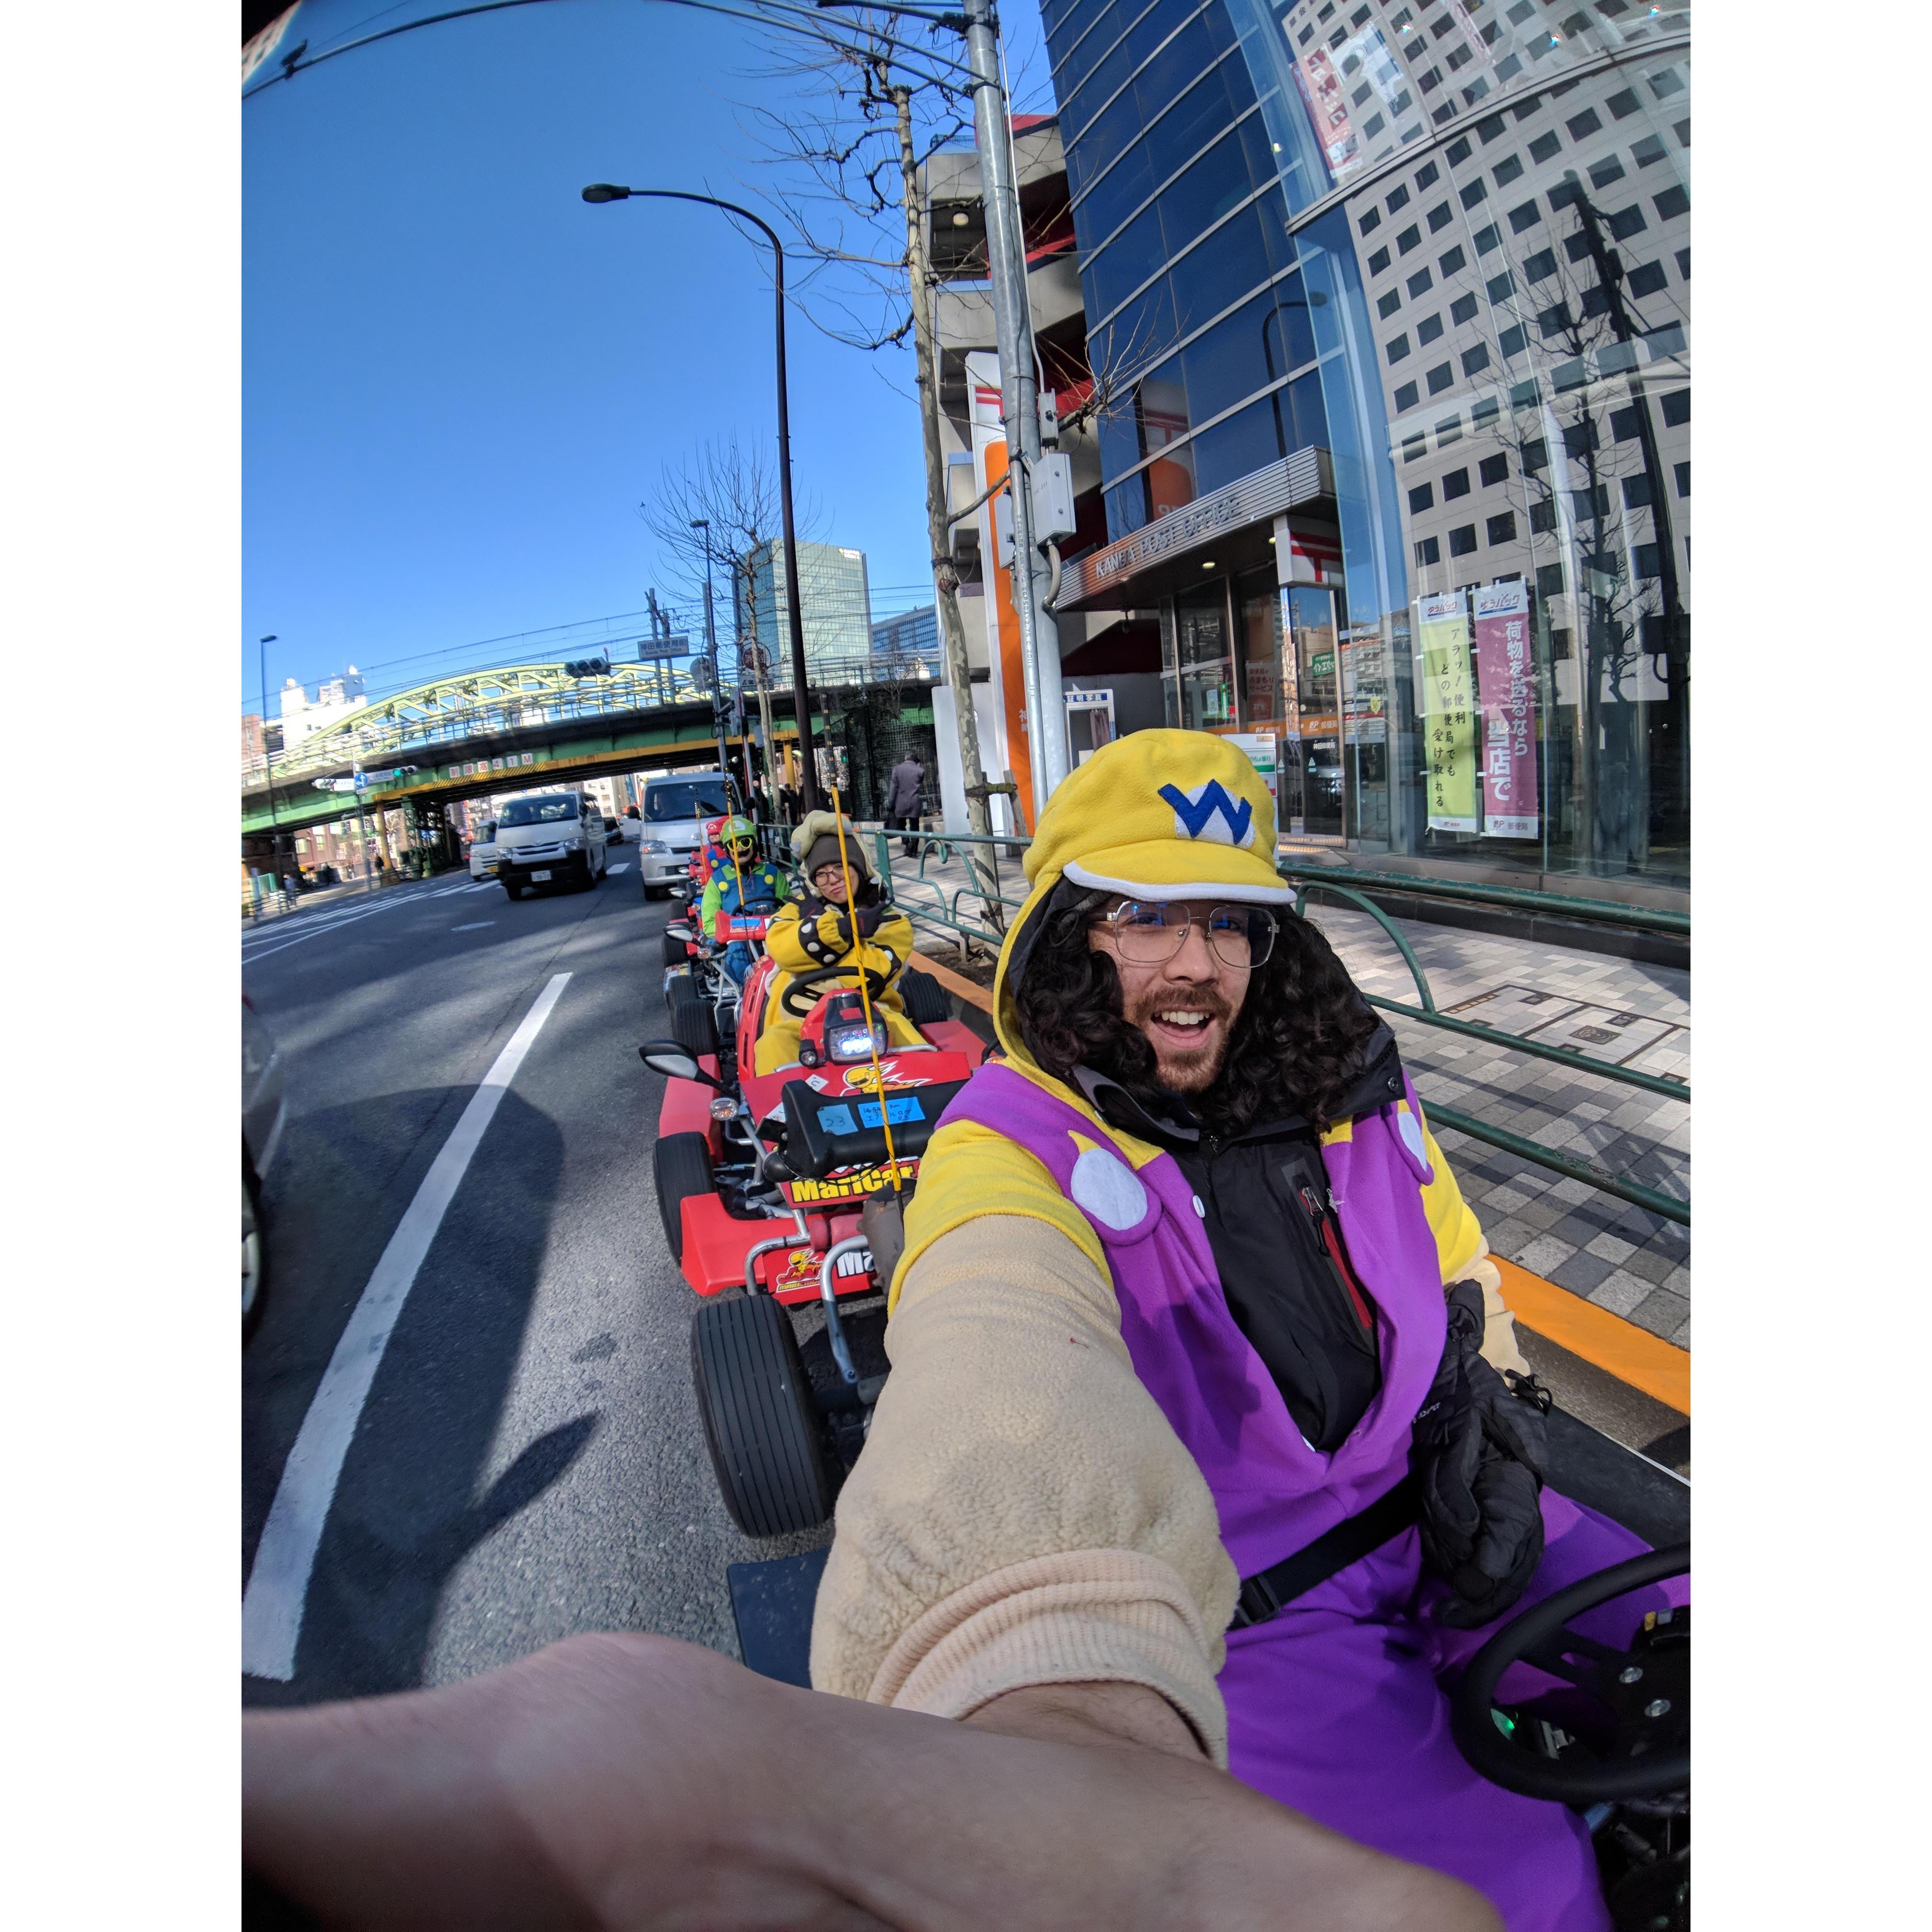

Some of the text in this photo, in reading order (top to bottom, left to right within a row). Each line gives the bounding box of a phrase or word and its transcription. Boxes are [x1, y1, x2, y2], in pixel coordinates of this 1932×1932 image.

[1095, 545, 1136, 578] KANDA
[1139, 526, 1176, 558] POST
[1182, 496, 1238, 538] OFFICE
[1427, 601, 1457, 613] ゆうパック
[1480, 592, 1520, 610] ゆうパック
[1067, 693, 1102, 702] 証明写真
[1440, 663, 1456, 776] どの郵便局でも
[1505, 620, 1529, 756] 荷物を送るなら
[1433, 728, 1444, 807] 受け取れる
[1487, 720, 1511, 801] 当店で
[1158, 779, 1253, 846] W
[1508, 822, 1529, 831] 郵便局
[791, 1165, 914, 1203] MariCar
